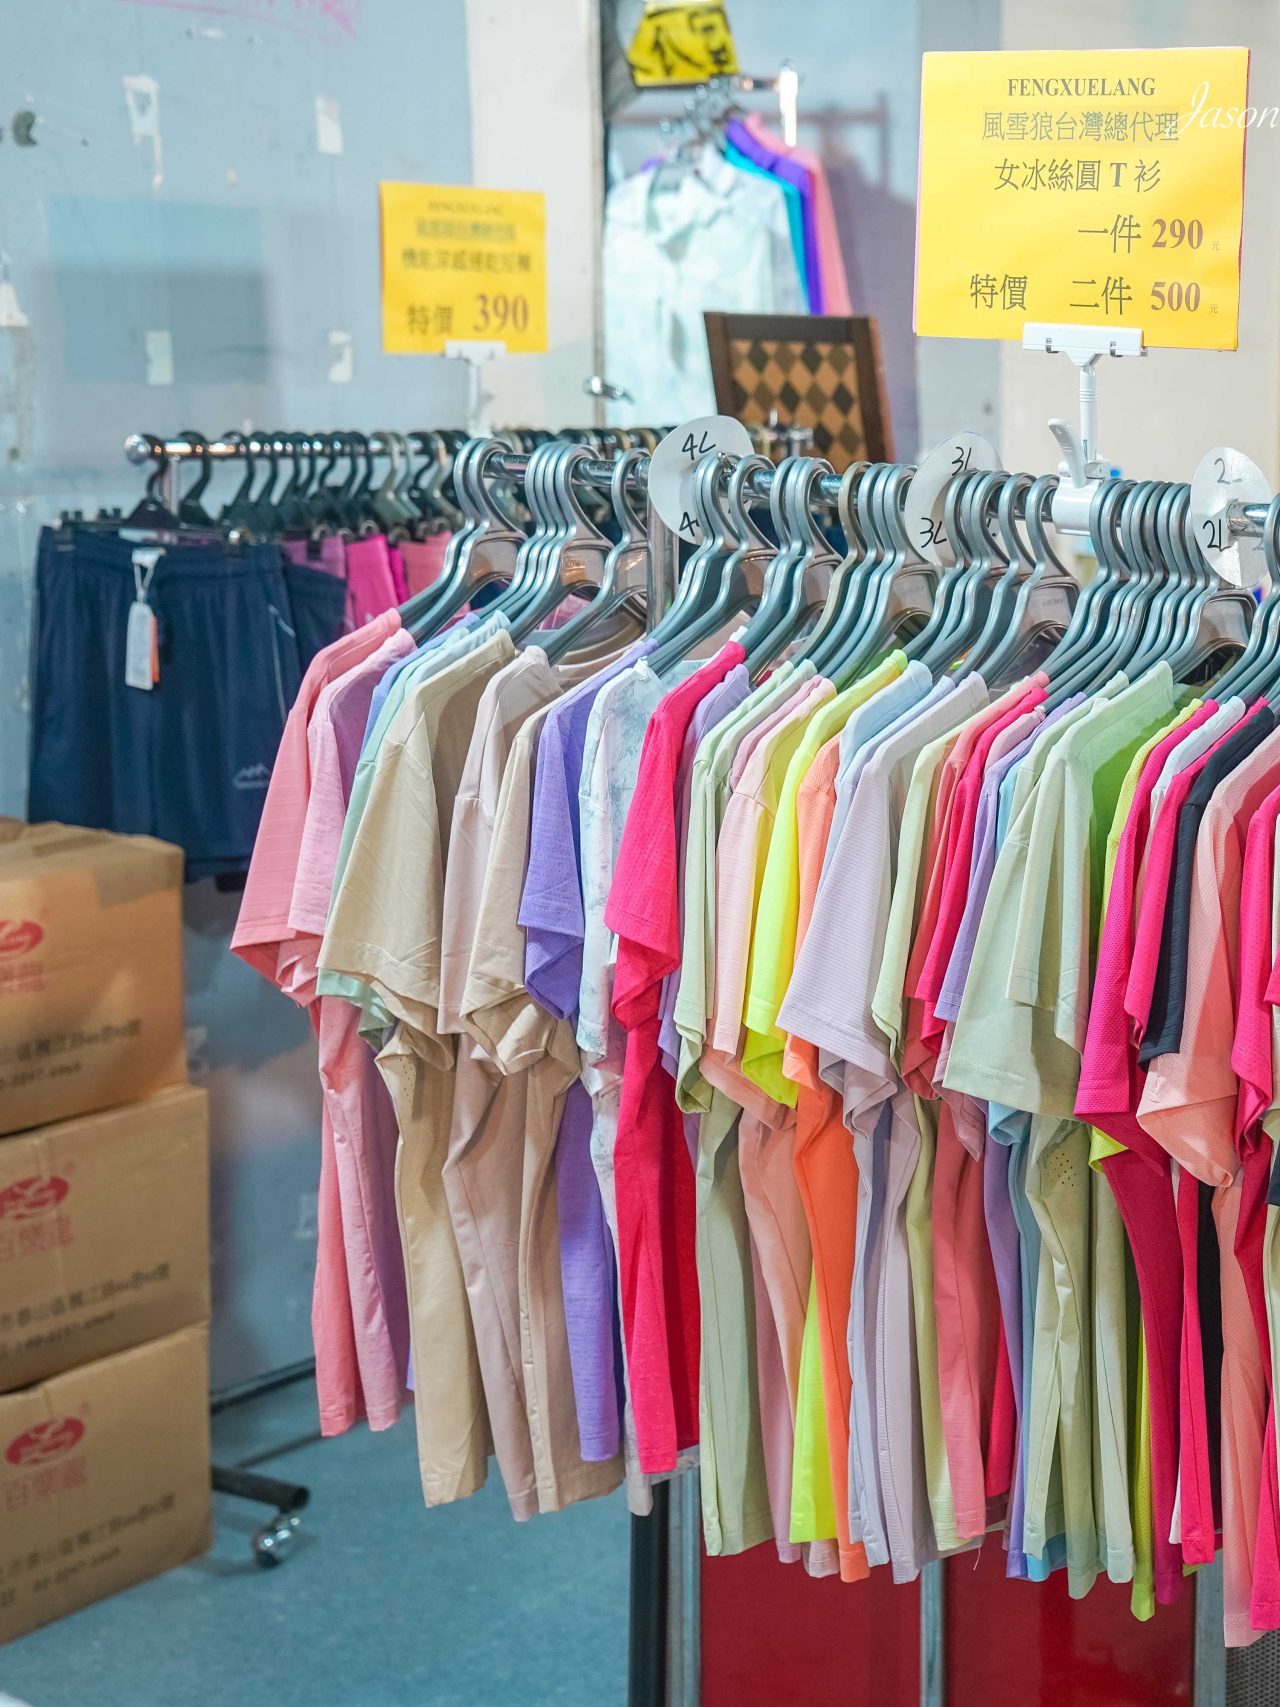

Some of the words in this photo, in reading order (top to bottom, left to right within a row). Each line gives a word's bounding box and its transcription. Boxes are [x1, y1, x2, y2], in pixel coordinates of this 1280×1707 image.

[1007, 77, 1156, 97] FENGXUELANG
[981, 111, 1180, 143] 風雪狼台灣總代理
[994, 159, 1102, 192] 女冰絲圓
[1110, 162, 1127, 187] T
[1134, 159, 1161, 193] 衫
[1077, 214, 1142, 254] 一件
[1151, 218, 1204, 250] 290
[970, 273, 1028, 311] 特價
[1069, 275, 1133, 315] 二件
[1150, 281, 1201, 312] 500
[407, 305, 454, 336] 特價
[473, 293, 529, 333] 390
[681, 431, 717, 461] 4L
[920, 517, 947, 548] 3L
[1202, 518, 1233, 553] 2L
